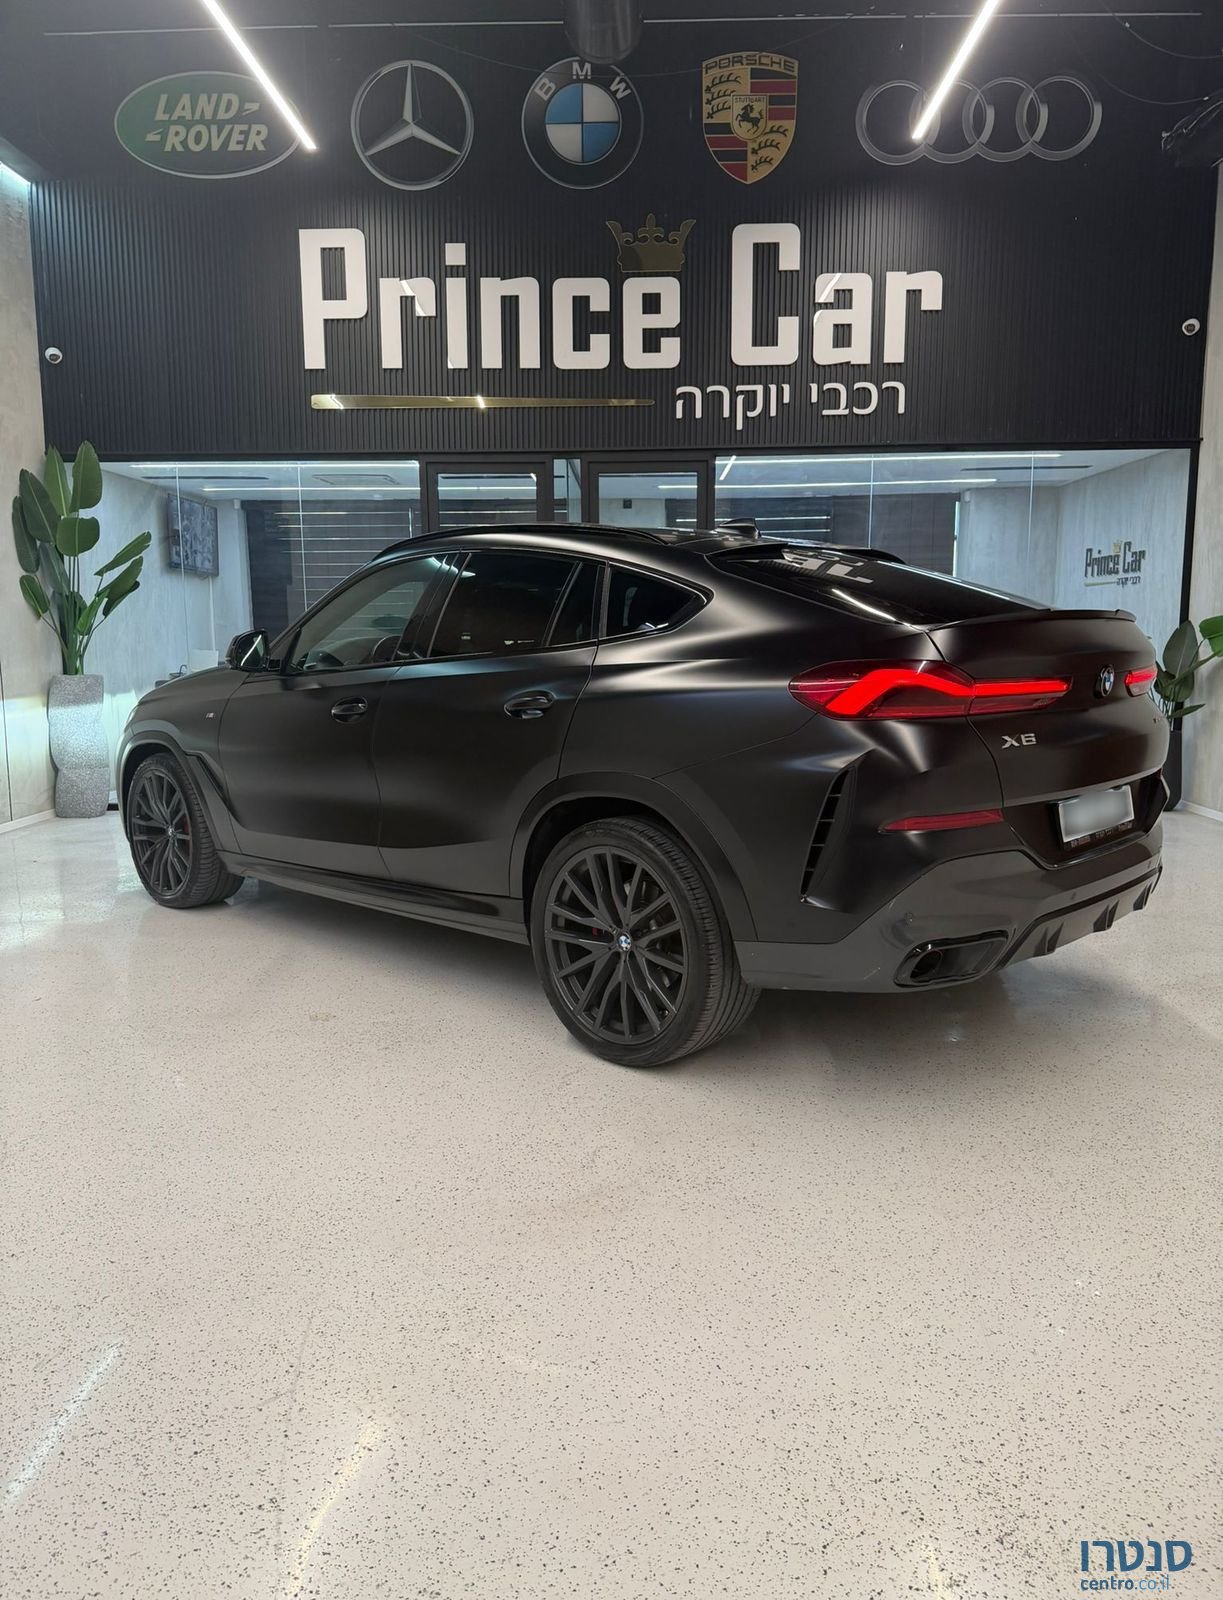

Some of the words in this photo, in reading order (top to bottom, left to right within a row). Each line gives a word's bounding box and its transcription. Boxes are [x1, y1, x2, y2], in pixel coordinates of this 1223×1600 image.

[534, 61, 632, 102] BMW
[704, 55, 795, 74] PORSCHE
[154, 92, 241, 121] LAND
[163, 123, 269, 152] ROVER
[298, 228, 681, 370] Prince
[731, 223, 943, 366] Car
[674, 383, 791, 431] יוקרה
[808, 381, 907, 417] רכבי
[1084, 547, 1121, 578] Prince
[1122, 541, 1146, 573] Car
[1001, 733, 1037, 749] X6
